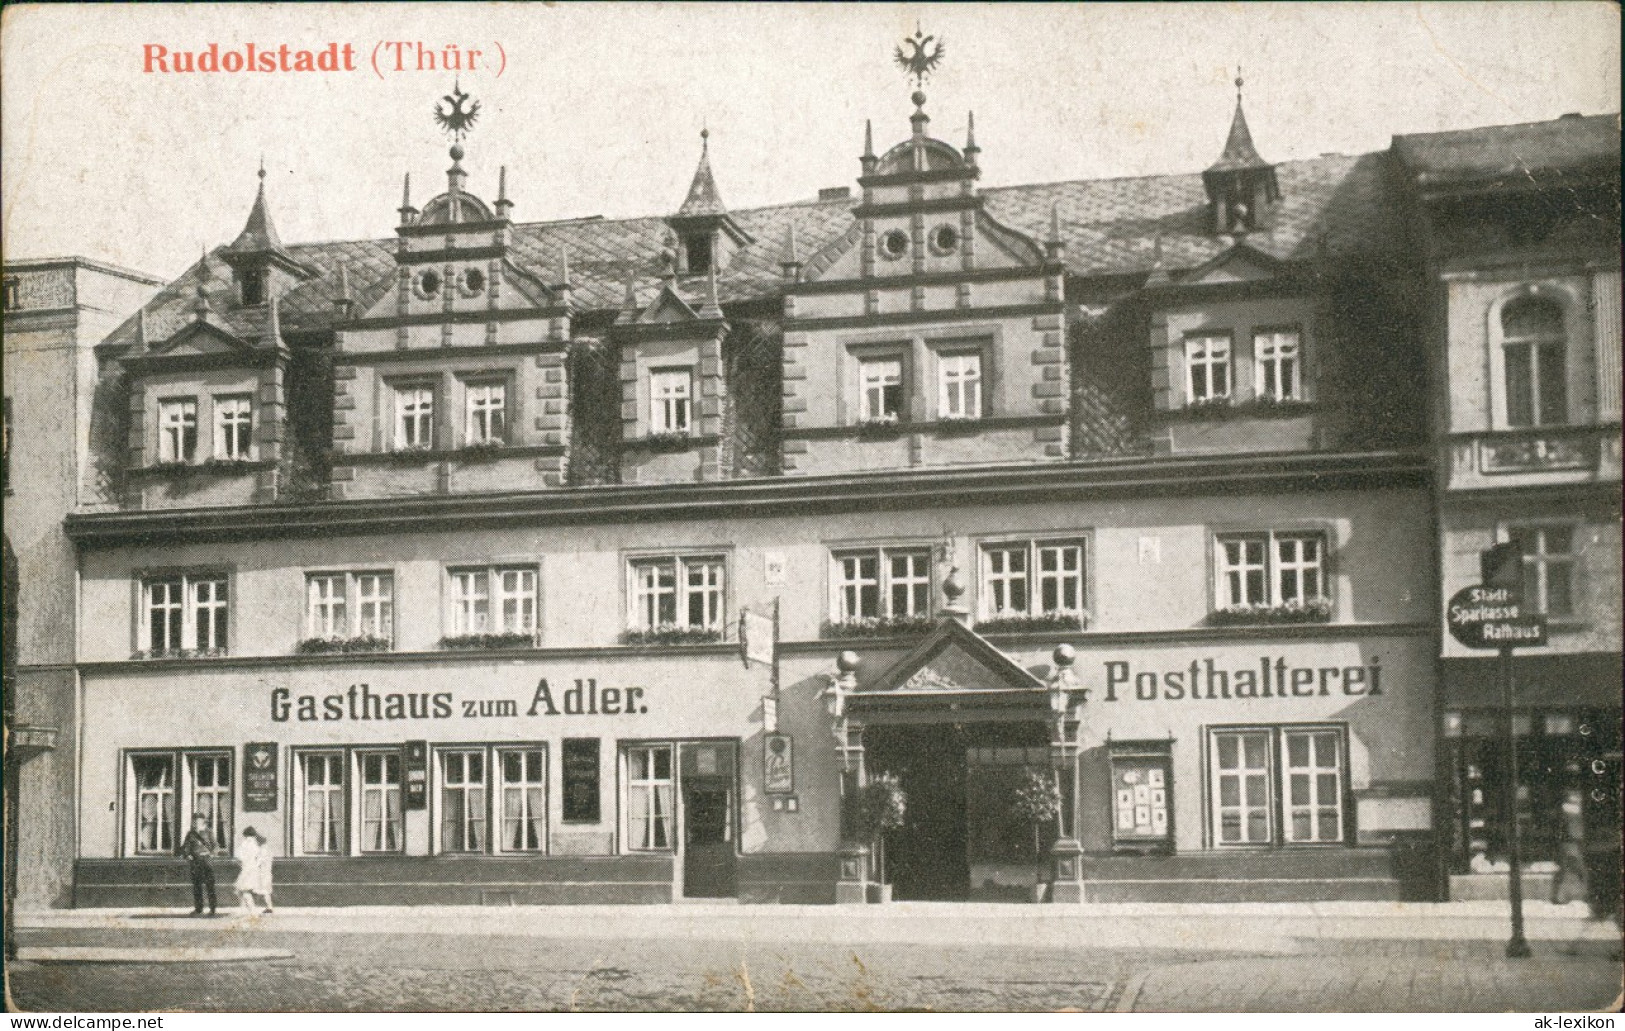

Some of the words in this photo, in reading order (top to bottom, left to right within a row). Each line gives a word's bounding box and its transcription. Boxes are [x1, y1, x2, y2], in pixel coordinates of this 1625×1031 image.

[1451, 604, 1519, 625] Sparkasse
[1483, 623, 1540, 639] Rathaus
[1103, 656, 1384, 702] Posthalterei
[271, 683, 453, 722] Gasthaus
[461, 699, 518, 718] zum
[527, 678, 649, 716] Adler.
